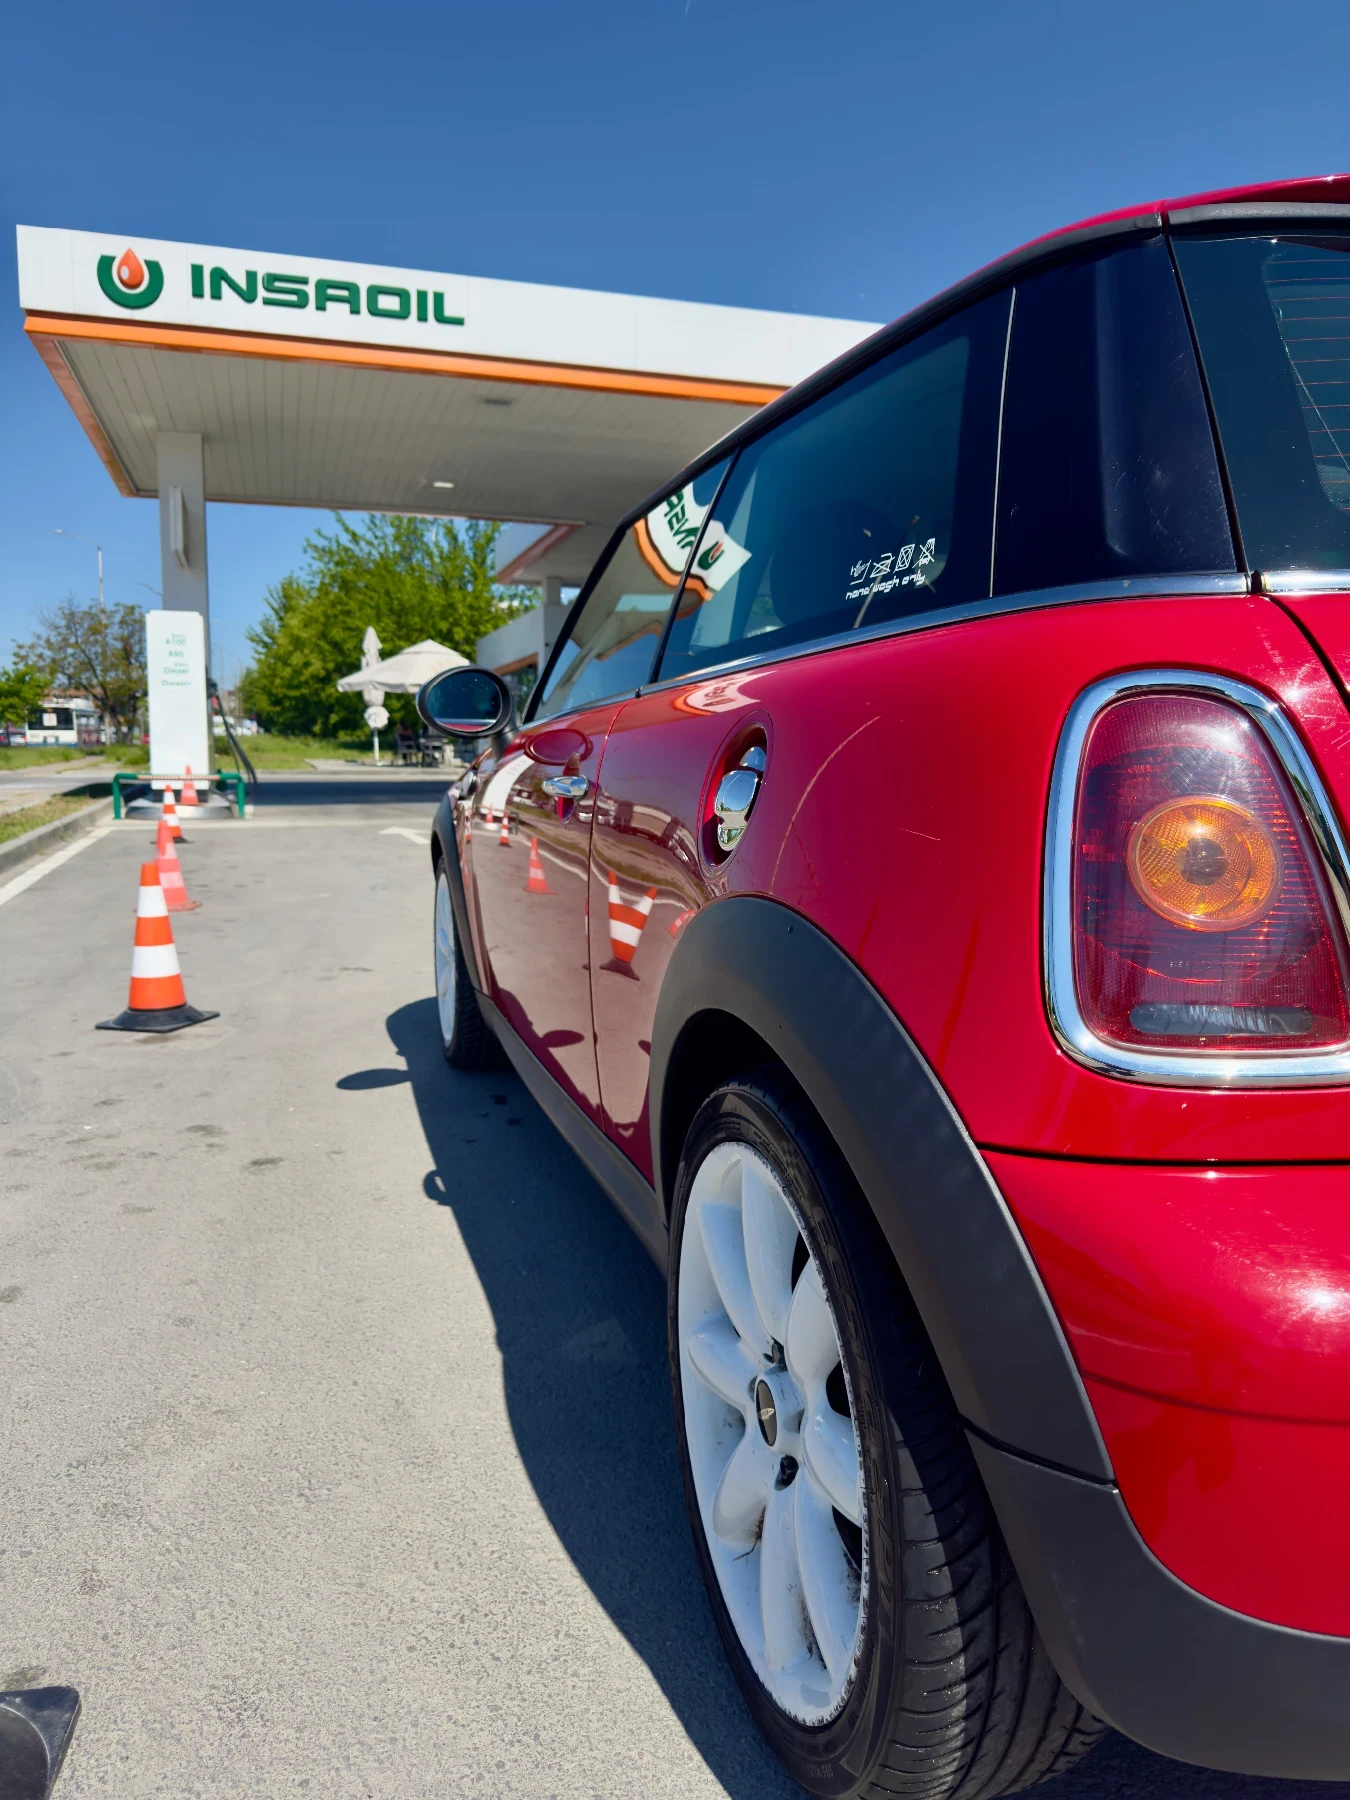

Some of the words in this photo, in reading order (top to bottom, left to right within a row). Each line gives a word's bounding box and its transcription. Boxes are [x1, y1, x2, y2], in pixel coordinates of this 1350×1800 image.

[191, 263, 465, 326] INSAOIL
[872, 576, 900, 593] wash
[901, 569, 926, 586] only
[163, 667, 190, 675] Diesel
